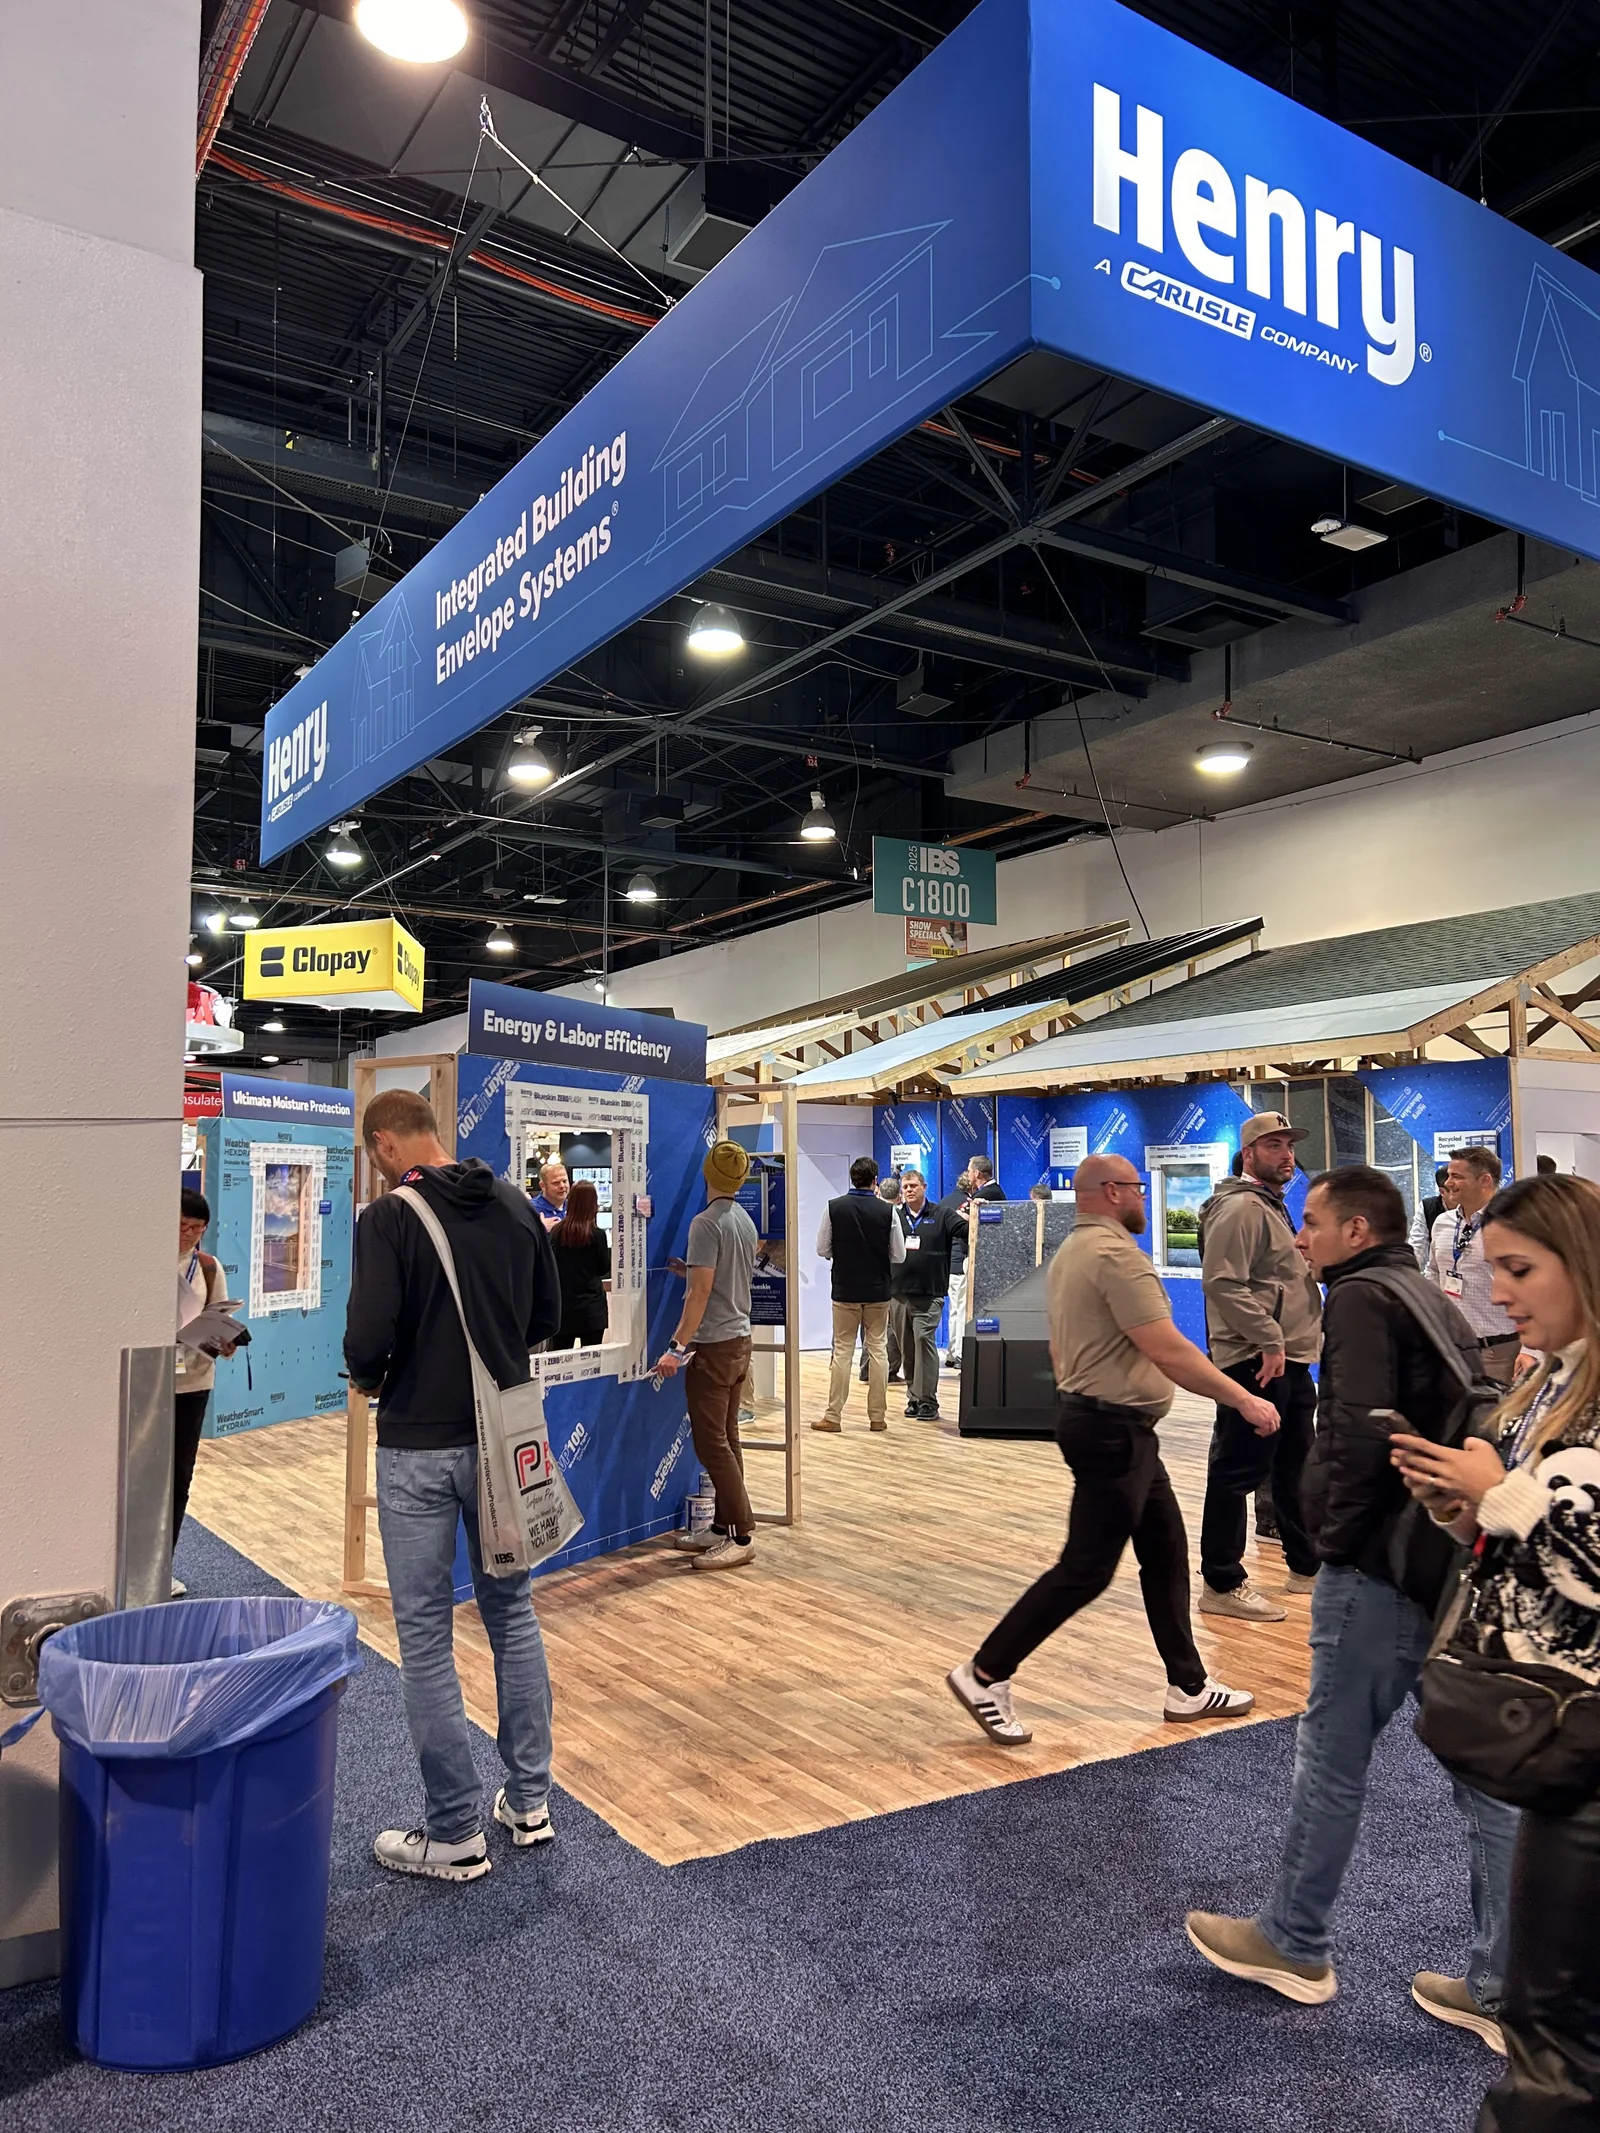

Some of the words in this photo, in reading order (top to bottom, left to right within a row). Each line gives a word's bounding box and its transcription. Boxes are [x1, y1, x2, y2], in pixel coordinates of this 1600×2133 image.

[1094, 259, 1111, 275] A
[1124, 264, 1253, 338] CARLISLE
[1260, 326, 1359, 375] COMPANY
[436, 511, 526, 630] Integrated
[532, 430, 627, 546] Building
[436, 597, 514, 686] Envelope
[268, 700, 328, 804] Henry
[908, 845, 918, 872] 2025
[920, 847, 960, 876] IBS
[902, 877, 970, 918] C1800
[909, 920, 932, 930] SHOW
[404, 950, 421, 991] Clopay
[483, 1008, 542, 1044] Energy
[545, 1019, 557, 1042] &
[559, 1023, 602, 1048] Labor
[604, 1028, 671, 1064] Efficiency
[233, 1090, 272, 1109] Ultimate
[273, 1095, 309, 1113] Moisture
[310, 1100, 350, 1115] Protection
[534, 1092, 556, 1101] Blueskin
[600, 1098, 620, 1106] Blueskin
[270, 1392, 285, 1402] Henry
[216, 1407, 264, 1424] WeatherSmart
[483, 1457, 500, 1541] ProtectiveProducts.com
[529, 1523, 540, 1538] WE
[531, 1532, 545, 1550] YOU
[494, 1552, 515, 1565] IBS
